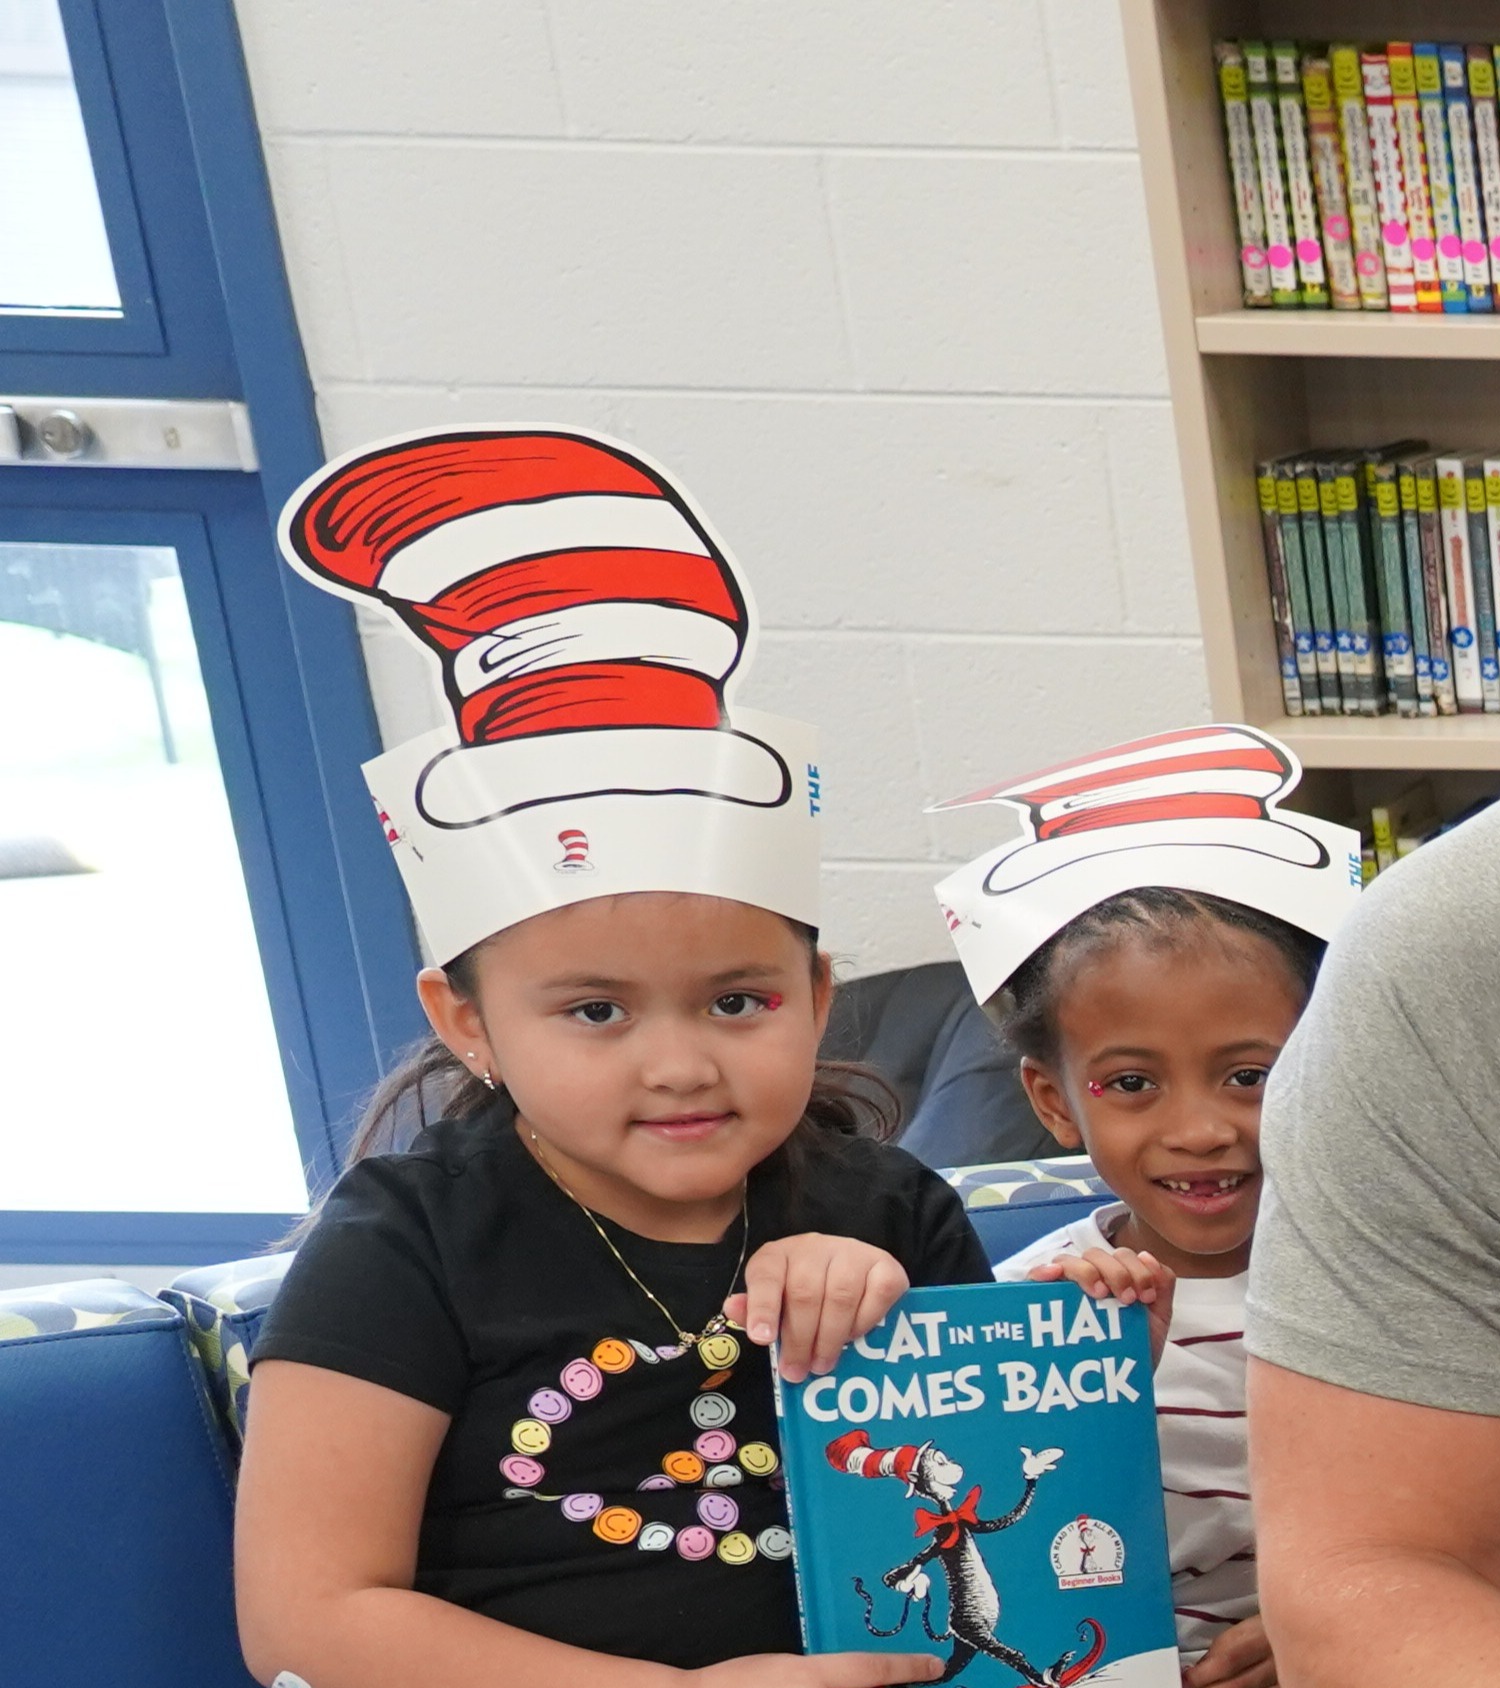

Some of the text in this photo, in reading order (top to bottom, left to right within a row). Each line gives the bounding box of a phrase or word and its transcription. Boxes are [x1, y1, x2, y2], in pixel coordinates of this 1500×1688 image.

[950, 1325, 974, 1344] IN
[981, 1322, 1024, 1342] THE
[1028, 1295, 1126, 1347] HAT
[803, 1356, 1141, 1423] COMES BACK
[1061, 1574, 1121, 1587] Beginner Books
